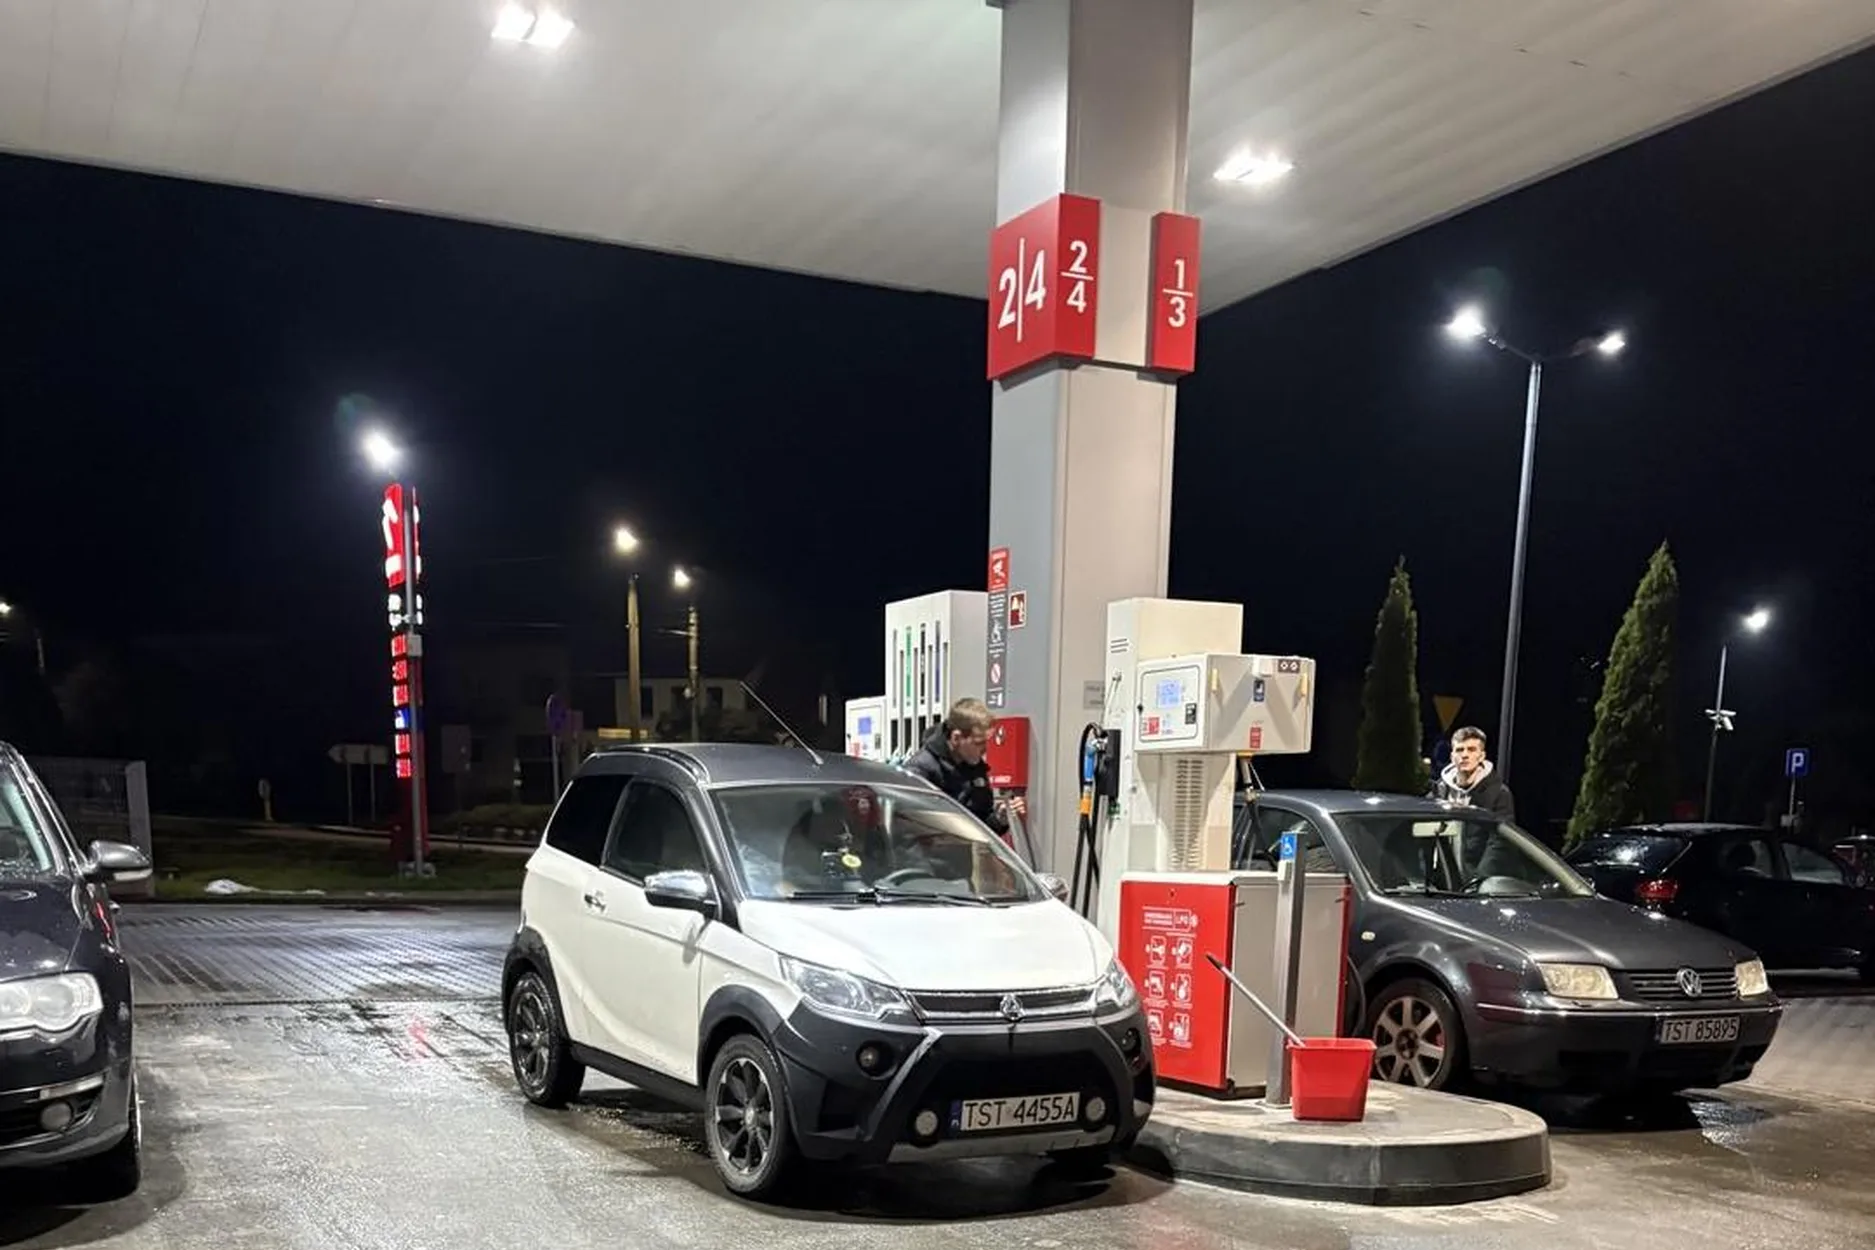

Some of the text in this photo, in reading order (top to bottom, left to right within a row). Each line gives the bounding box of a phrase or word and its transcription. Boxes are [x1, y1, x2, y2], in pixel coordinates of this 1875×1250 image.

[1069, 240, 1088, 273] 2
[1174, 259, 1186, 290] 1
[1067, 281, 1087, 314] 4
[1168, 296, 1186, 328] 3
[1791, 752, 1804, 773] P
[1665, 1021, 1692, 1040] TST
[964, 1095, 1075, 1128] TST 4455A
